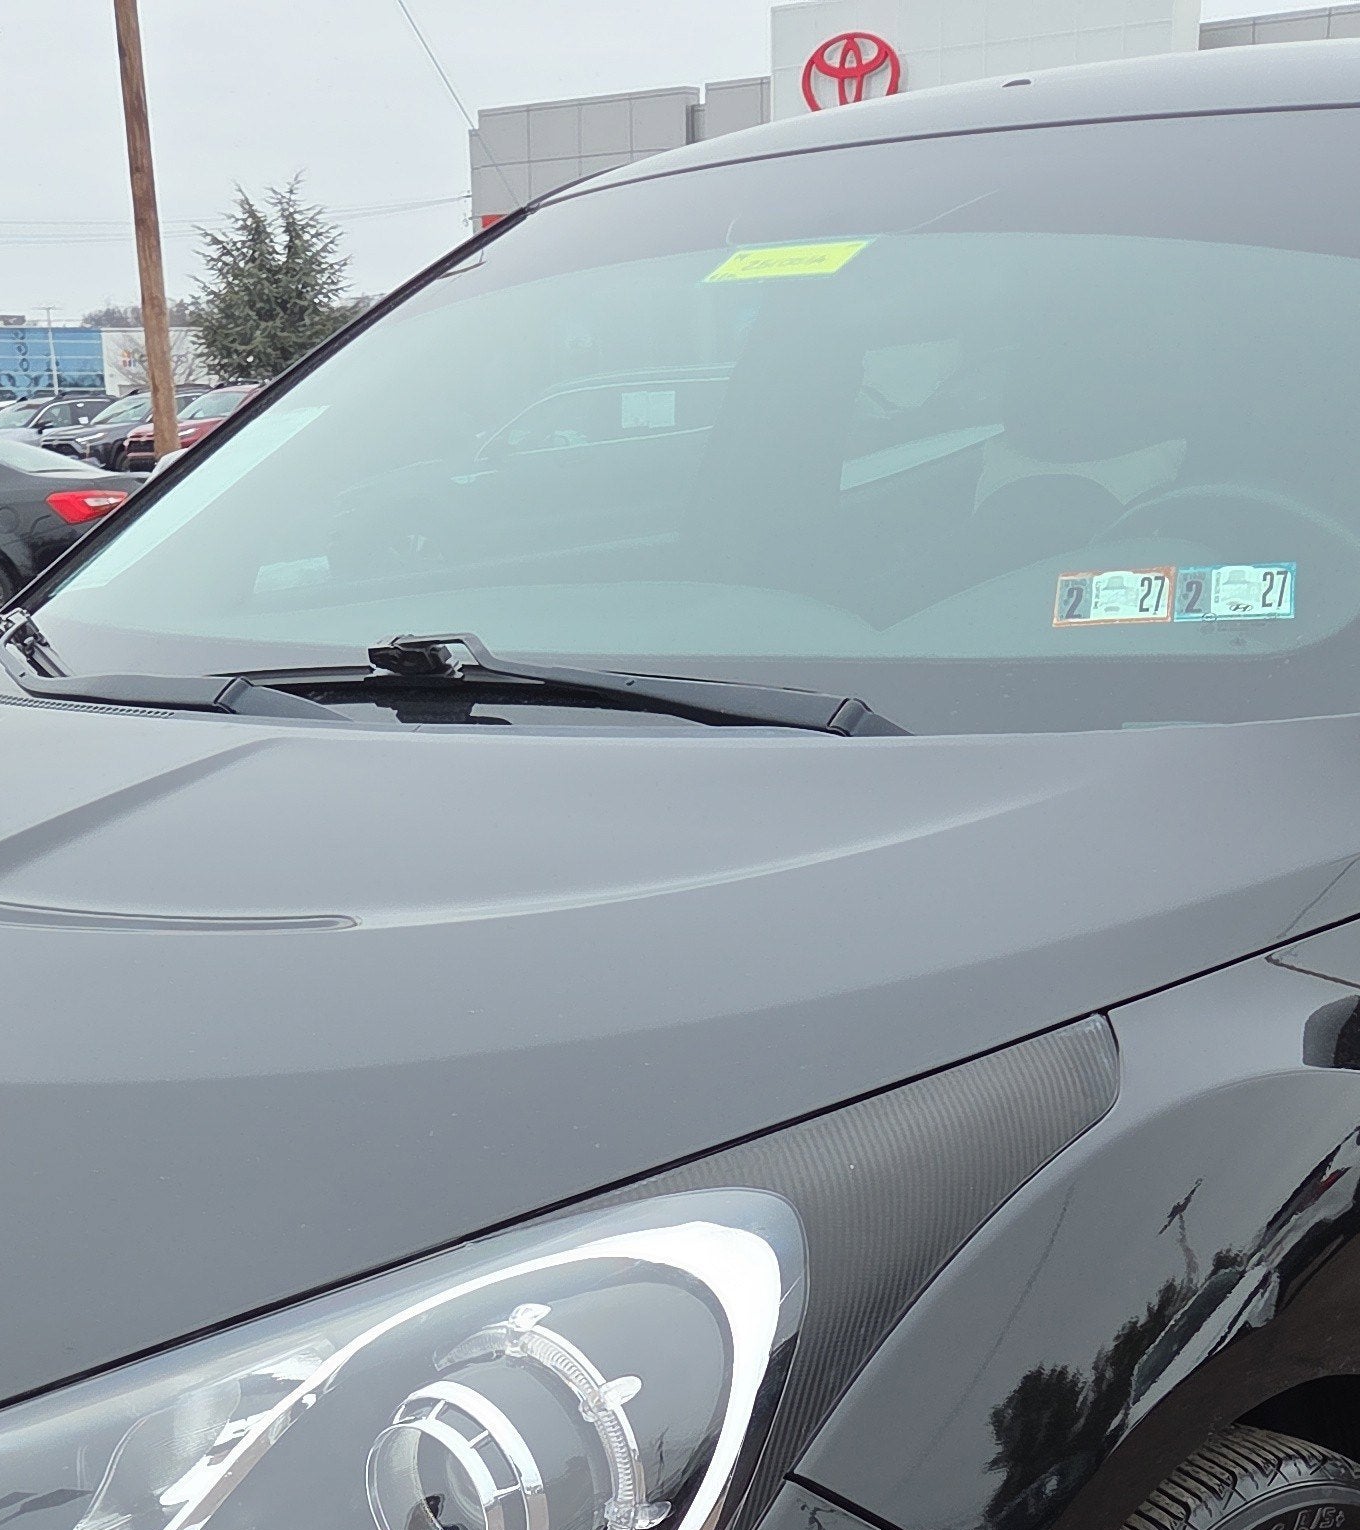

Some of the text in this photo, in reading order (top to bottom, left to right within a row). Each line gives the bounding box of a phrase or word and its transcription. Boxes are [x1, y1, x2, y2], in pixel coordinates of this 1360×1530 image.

[1065, 587, 1084, 620] 2
[1139, 575, 1166, 613] 27
[1185, 579, 1203, 614] 2
[1261, 570, 1289, 608] 27
